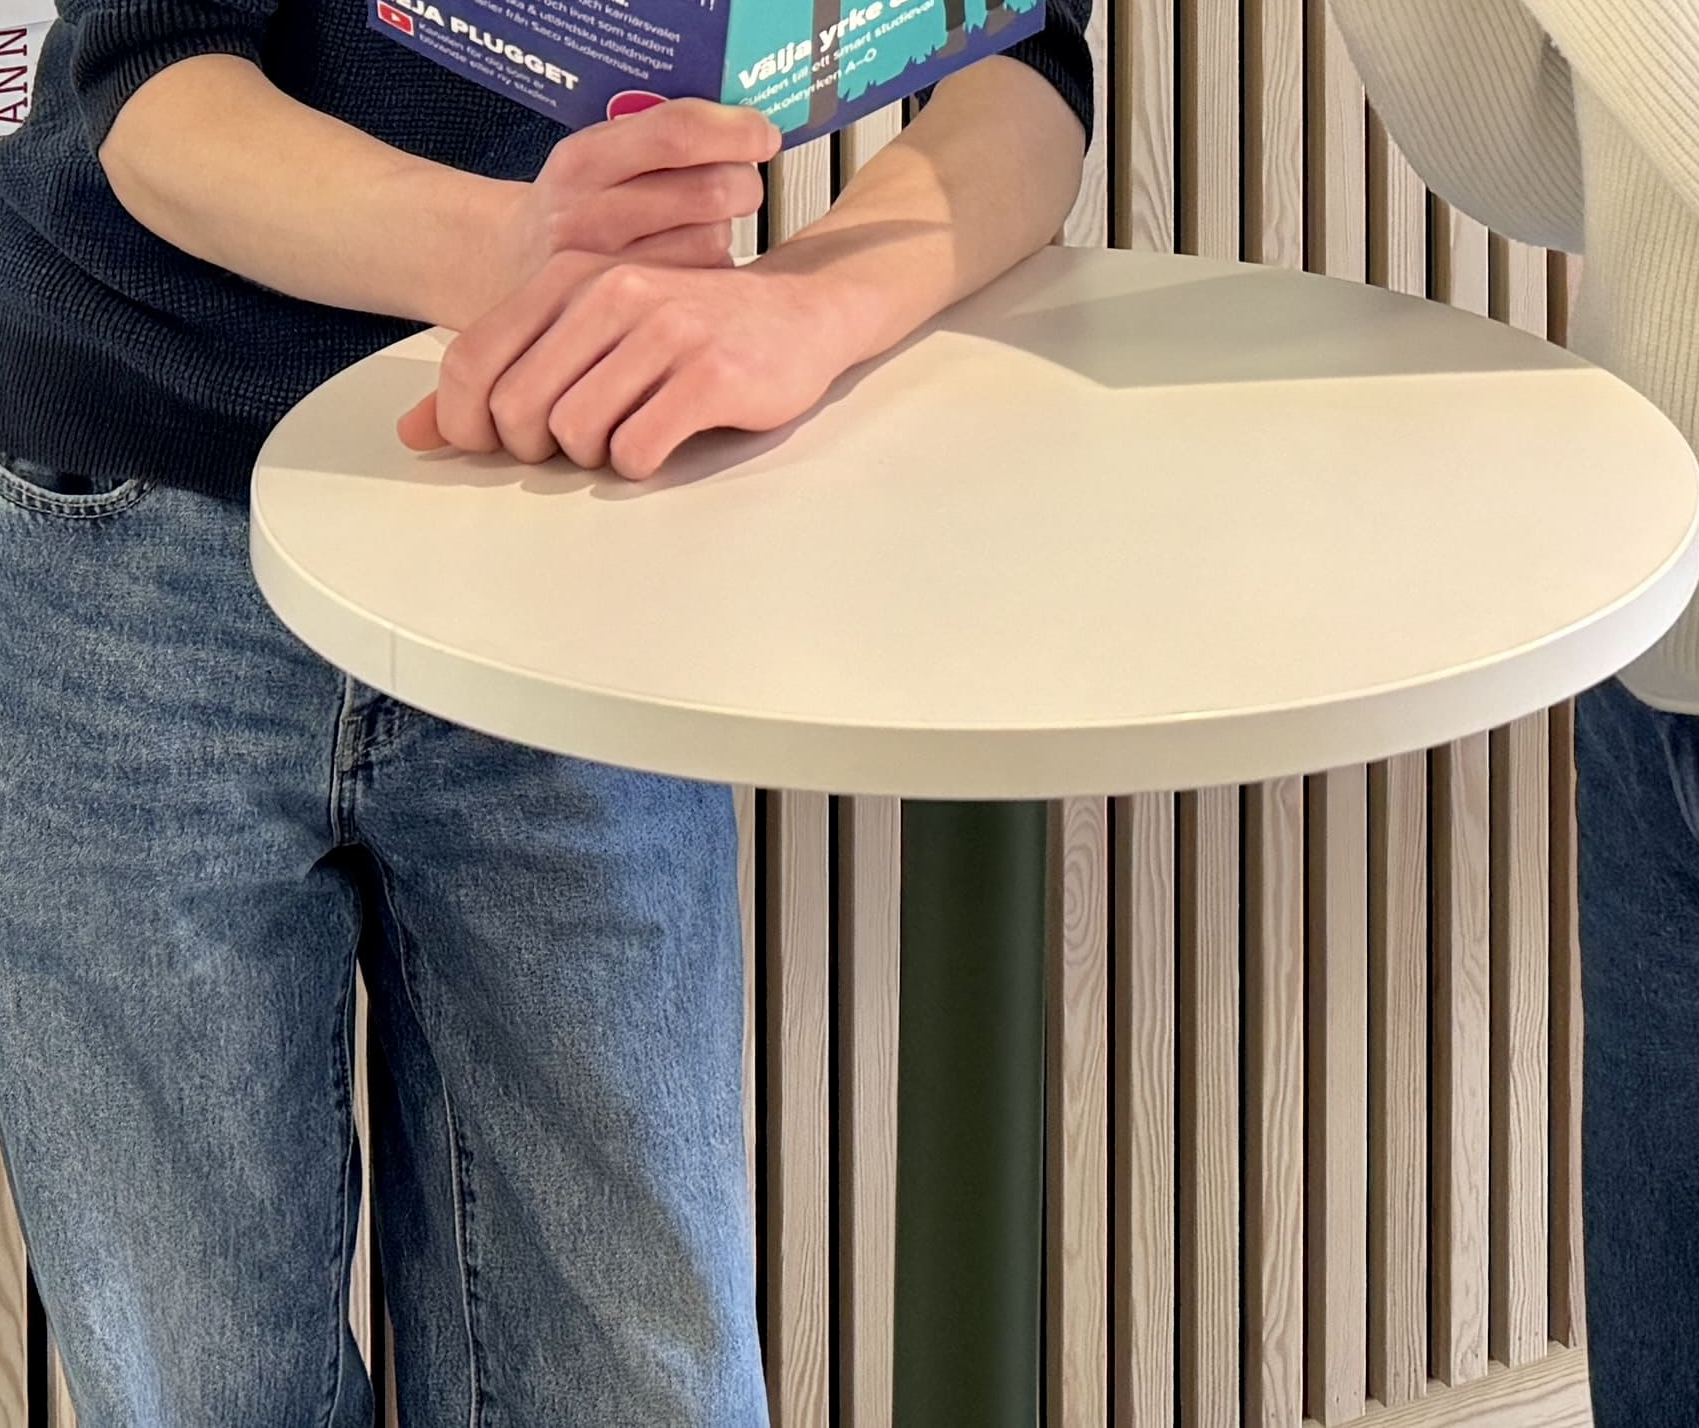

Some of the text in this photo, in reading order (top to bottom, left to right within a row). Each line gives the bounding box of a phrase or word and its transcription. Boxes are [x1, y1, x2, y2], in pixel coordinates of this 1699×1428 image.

[451, 16, 580, 90] PLUGGET
[738, 38, 812, 90] Välja
[819, 0, 883, 52] yrke
[833, 31, 872, 62] smart
[762, 69, 843, 116] skoleyrken
